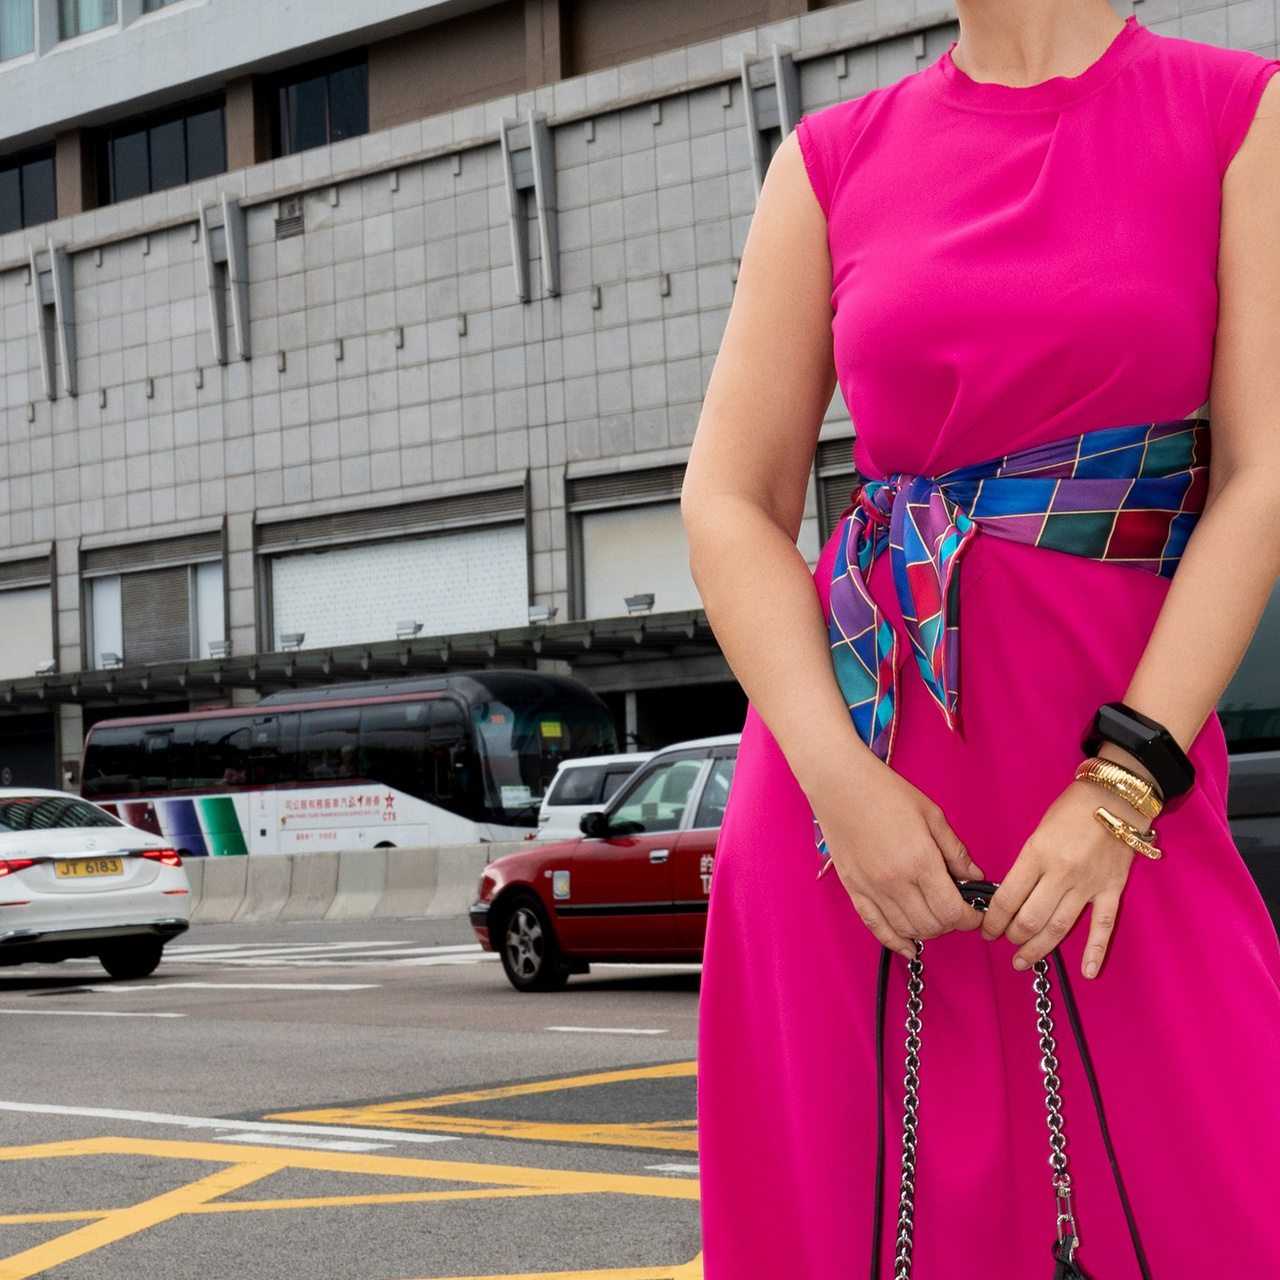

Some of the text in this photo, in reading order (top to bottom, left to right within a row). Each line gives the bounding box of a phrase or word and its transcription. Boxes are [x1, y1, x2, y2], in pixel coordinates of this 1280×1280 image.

[383, 811, 396, 821] CTS
[61, 860, 119, 875] JT 6183
[700, 873, 713, 894] T
